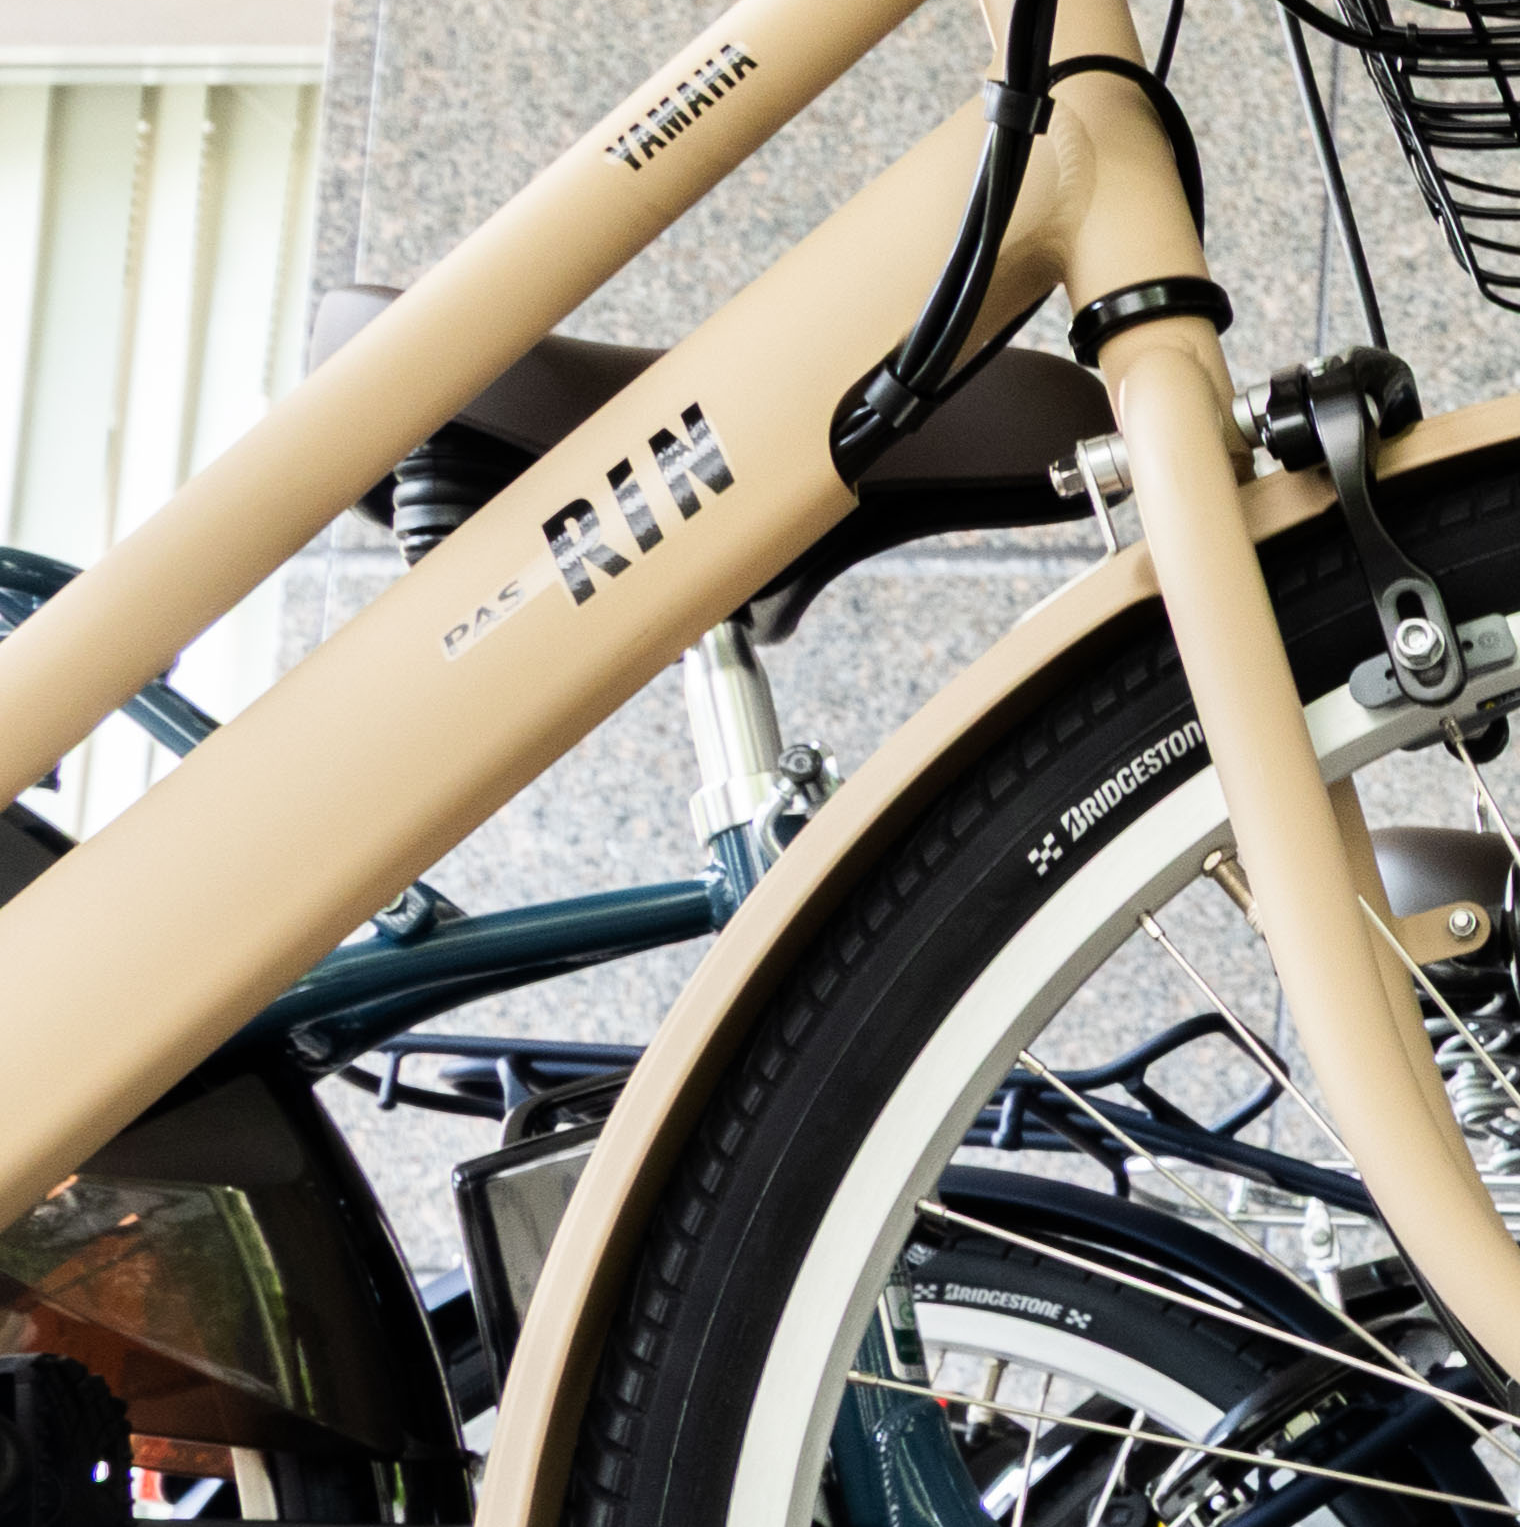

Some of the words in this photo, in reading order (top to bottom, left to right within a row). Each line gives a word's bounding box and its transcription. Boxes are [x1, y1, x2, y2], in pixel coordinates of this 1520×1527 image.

[605, 43, 758, 172] YAMAHA
[443, 580, 526, 657] PAS
[541, 402, 736, 607] RIN
[1060, 721, 1208, 844] BRIDGESTON
[943, 1282, 1063, 1320] BRIDGESTONE
